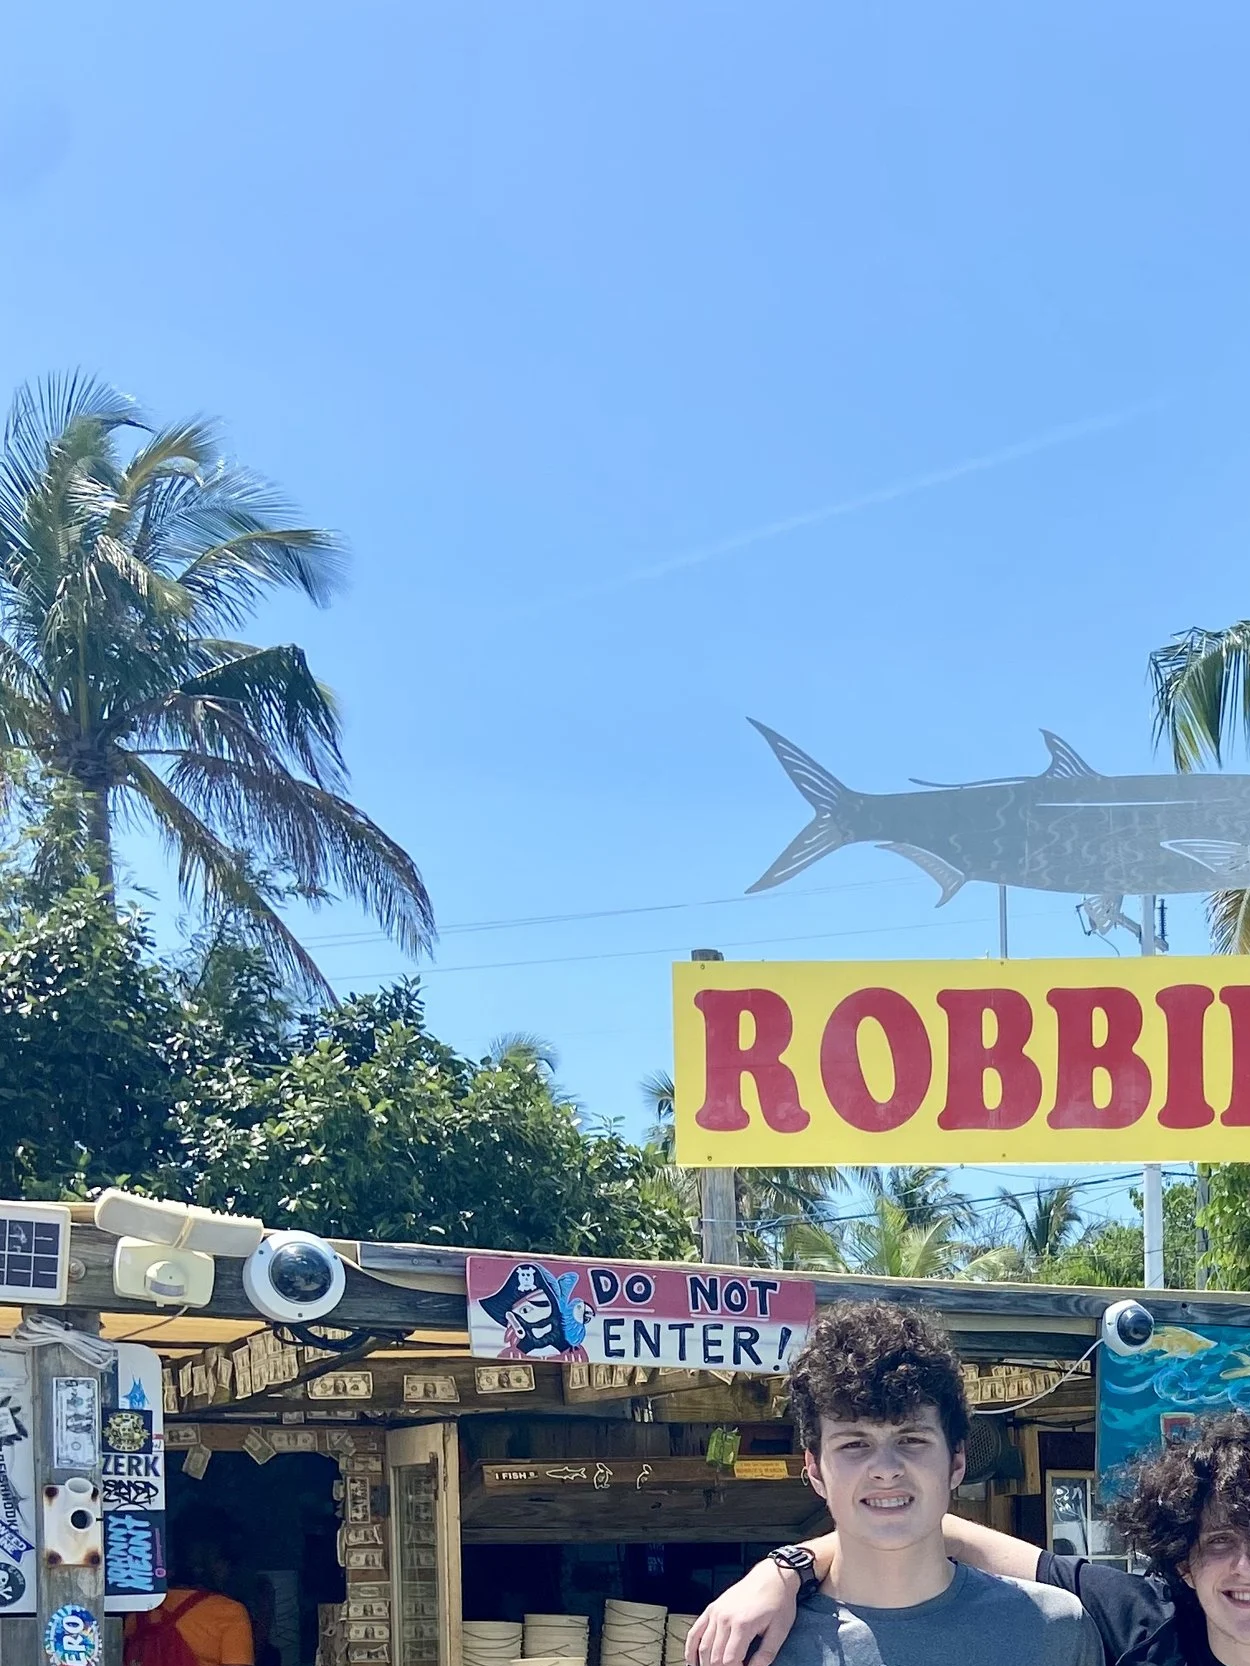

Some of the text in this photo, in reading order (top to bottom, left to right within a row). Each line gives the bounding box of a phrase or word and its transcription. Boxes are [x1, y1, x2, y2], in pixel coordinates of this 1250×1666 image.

[589, 1268, 779, 1317] DO NOT
[603, 1317, 792, 1373] ENTER!
[501, 1471, 527, 1480] FISH
